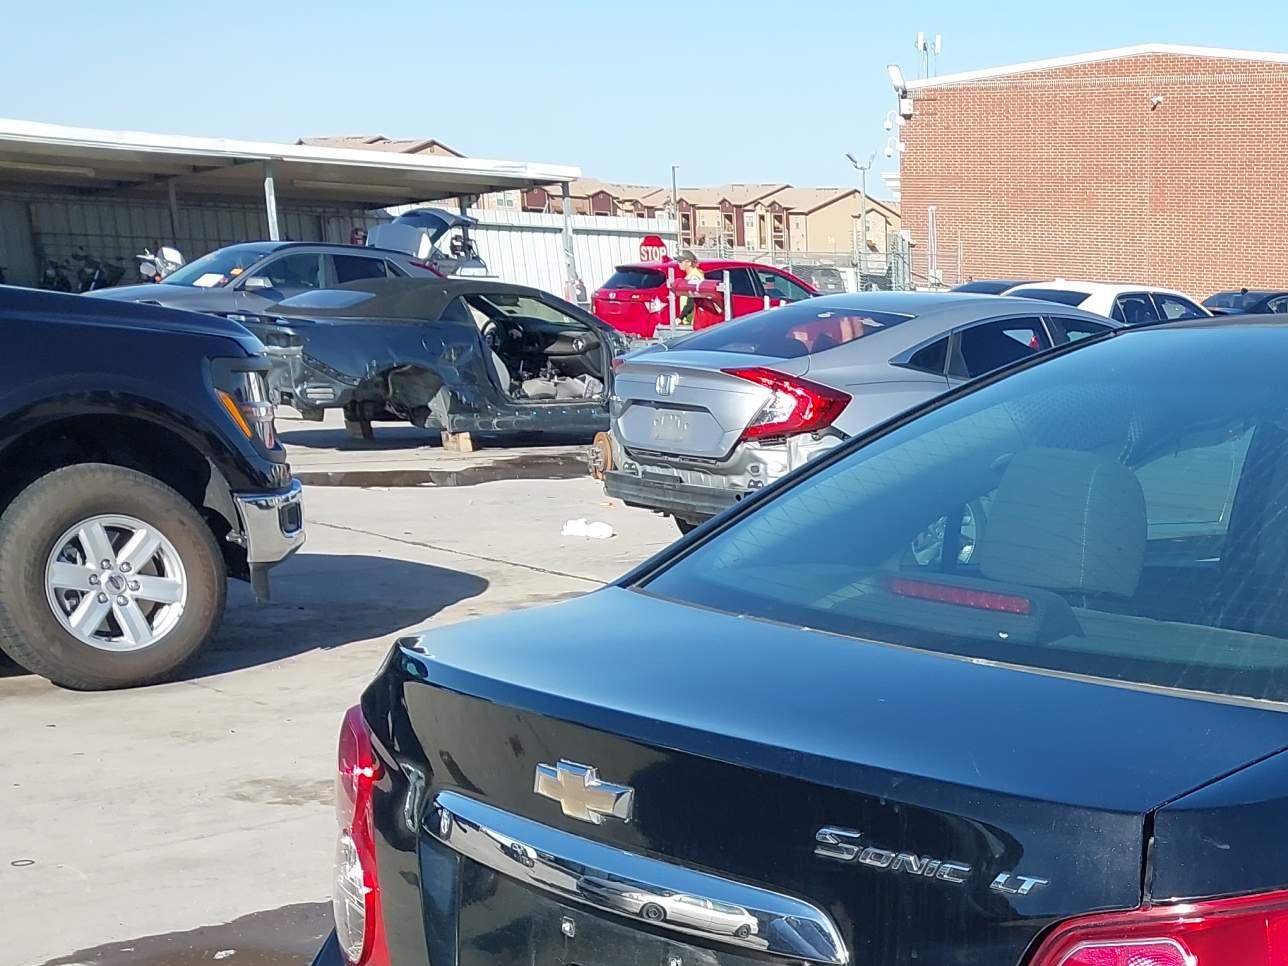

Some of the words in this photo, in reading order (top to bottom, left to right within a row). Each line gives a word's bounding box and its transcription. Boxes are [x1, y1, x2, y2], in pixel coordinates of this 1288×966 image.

[640, 245, 667, 261] STOP
[814, 825, 973, 884] SONIC
[989, 871, 1049, 895] LT
